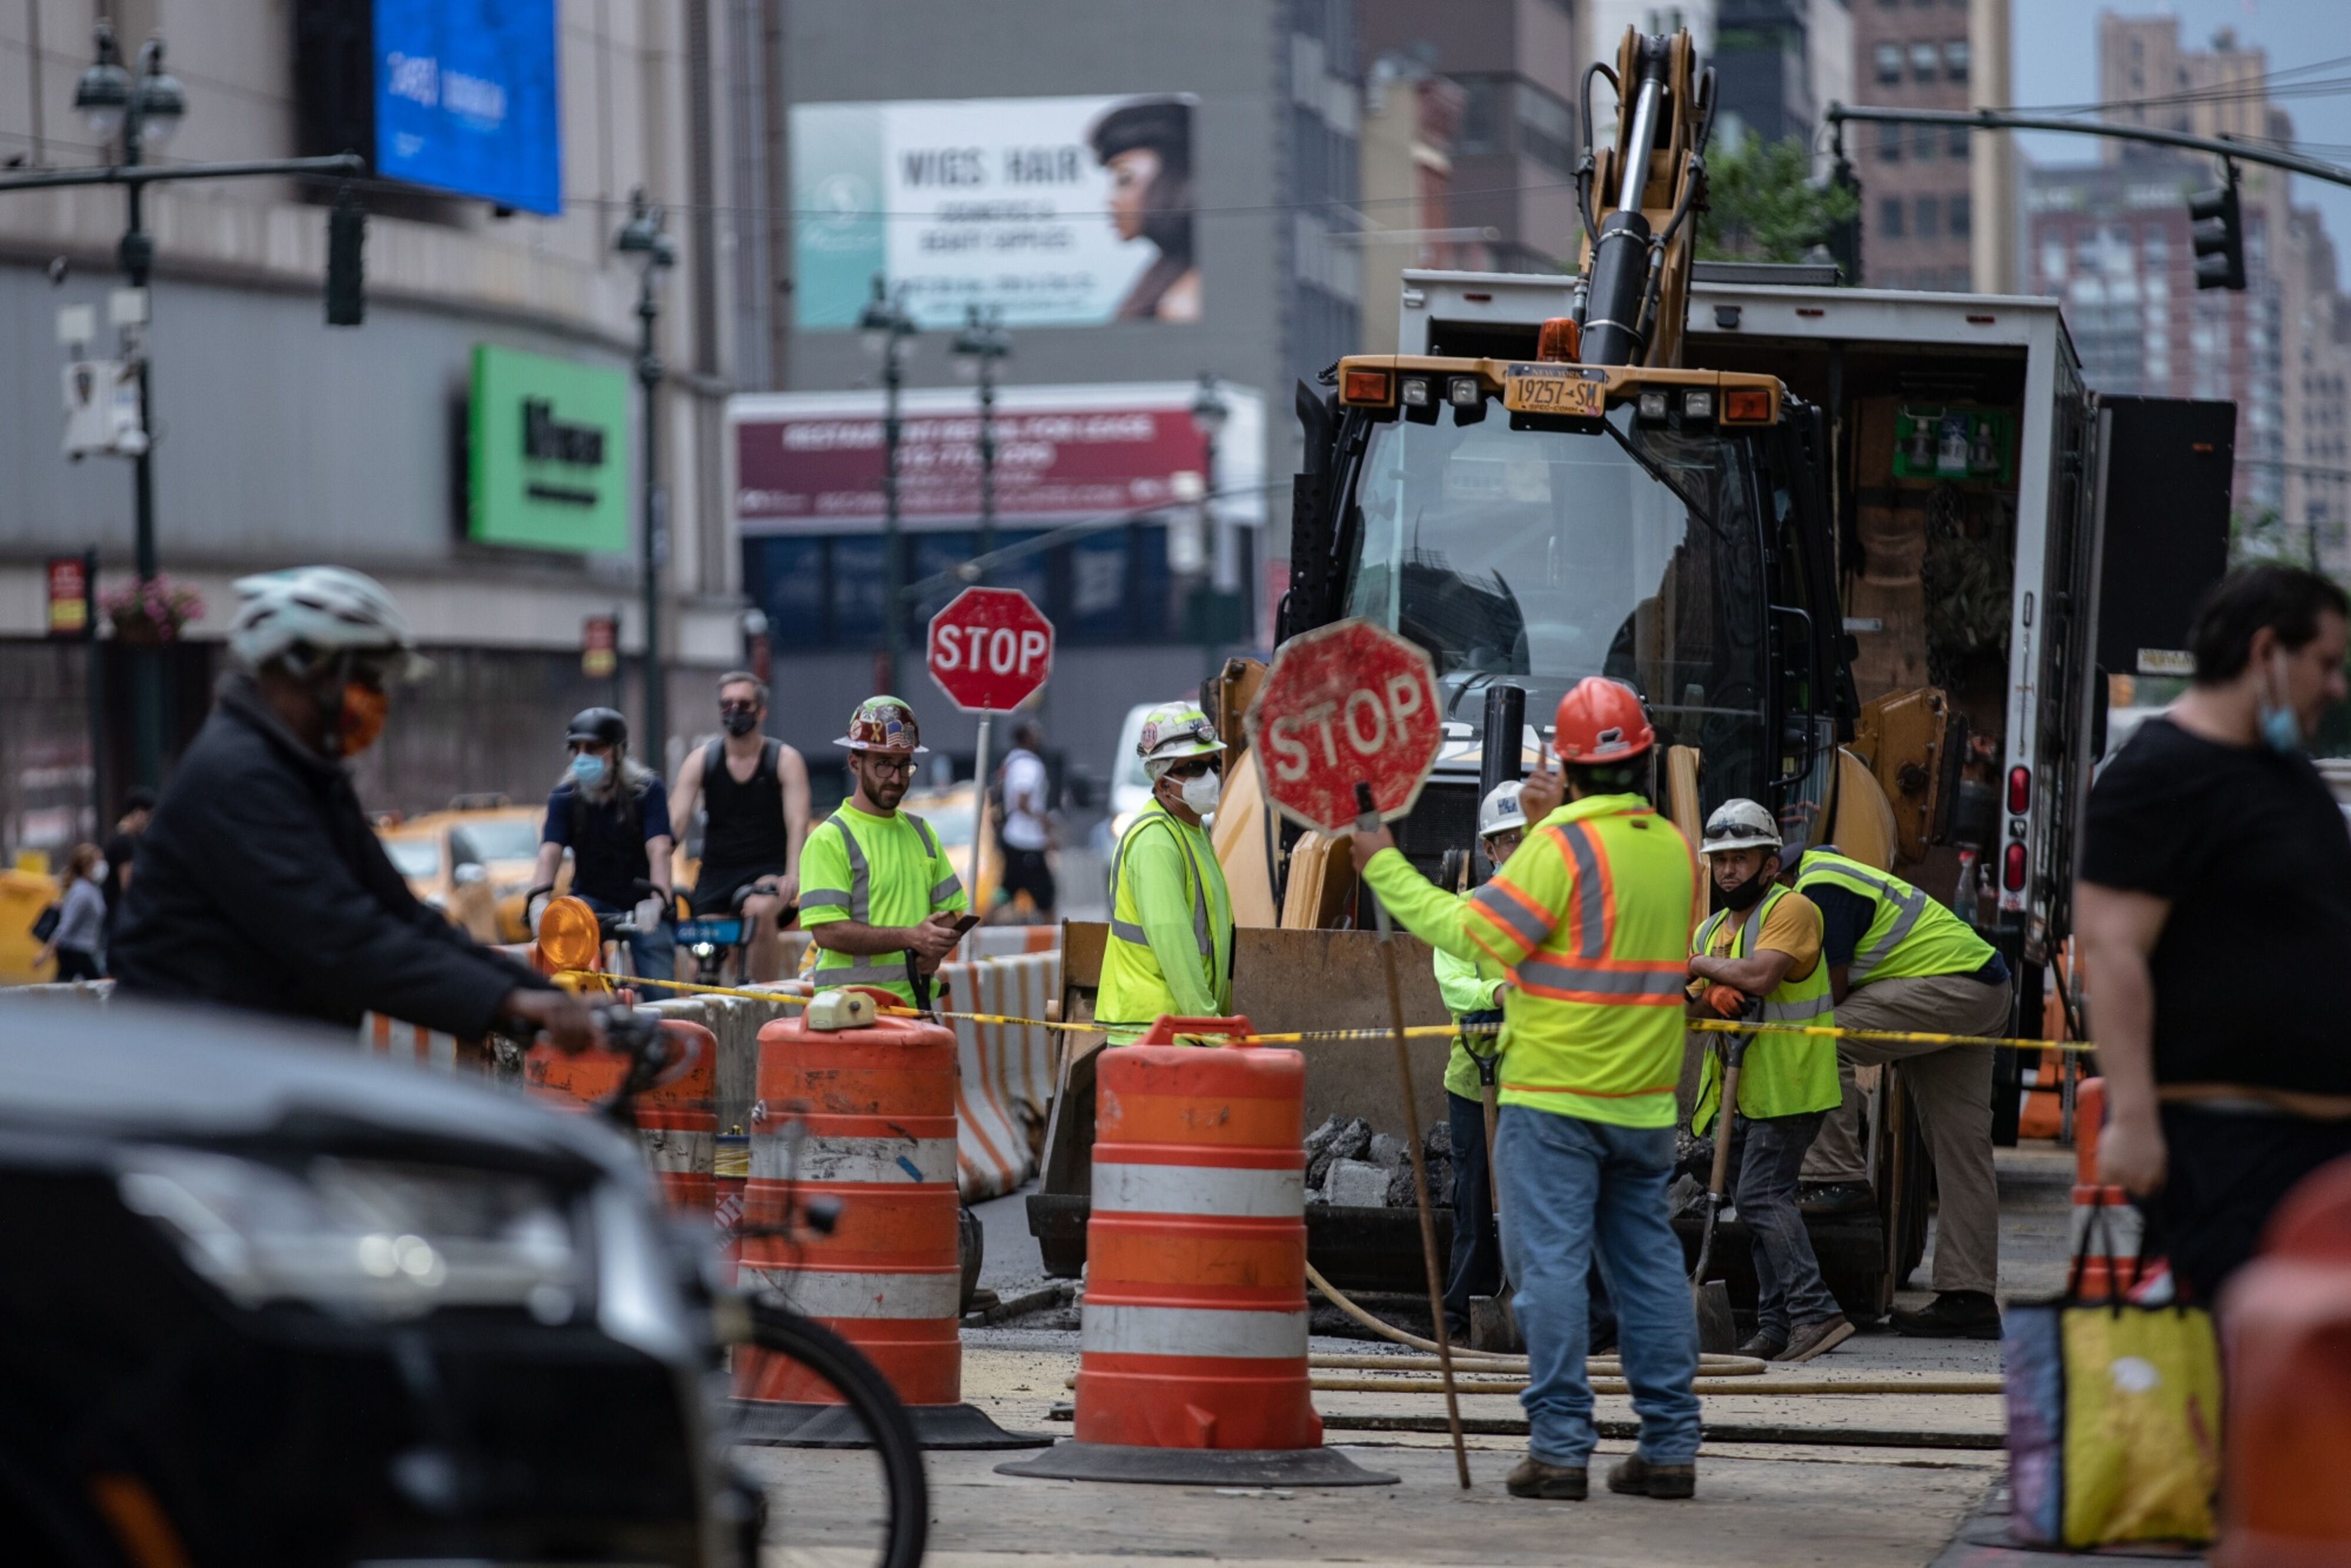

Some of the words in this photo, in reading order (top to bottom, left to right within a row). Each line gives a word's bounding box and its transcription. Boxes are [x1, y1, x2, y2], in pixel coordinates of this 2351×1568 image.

[899, 148, 983, 186] WIGS
[1003, 146, 1080, 185] HAIR
[1532, 368, 1555, 376] NEW
[1558, 369, 1582, 379] YORK
[935, 624, 1046, 675] STOP
[1269, 673, 1421, 781] STOP
